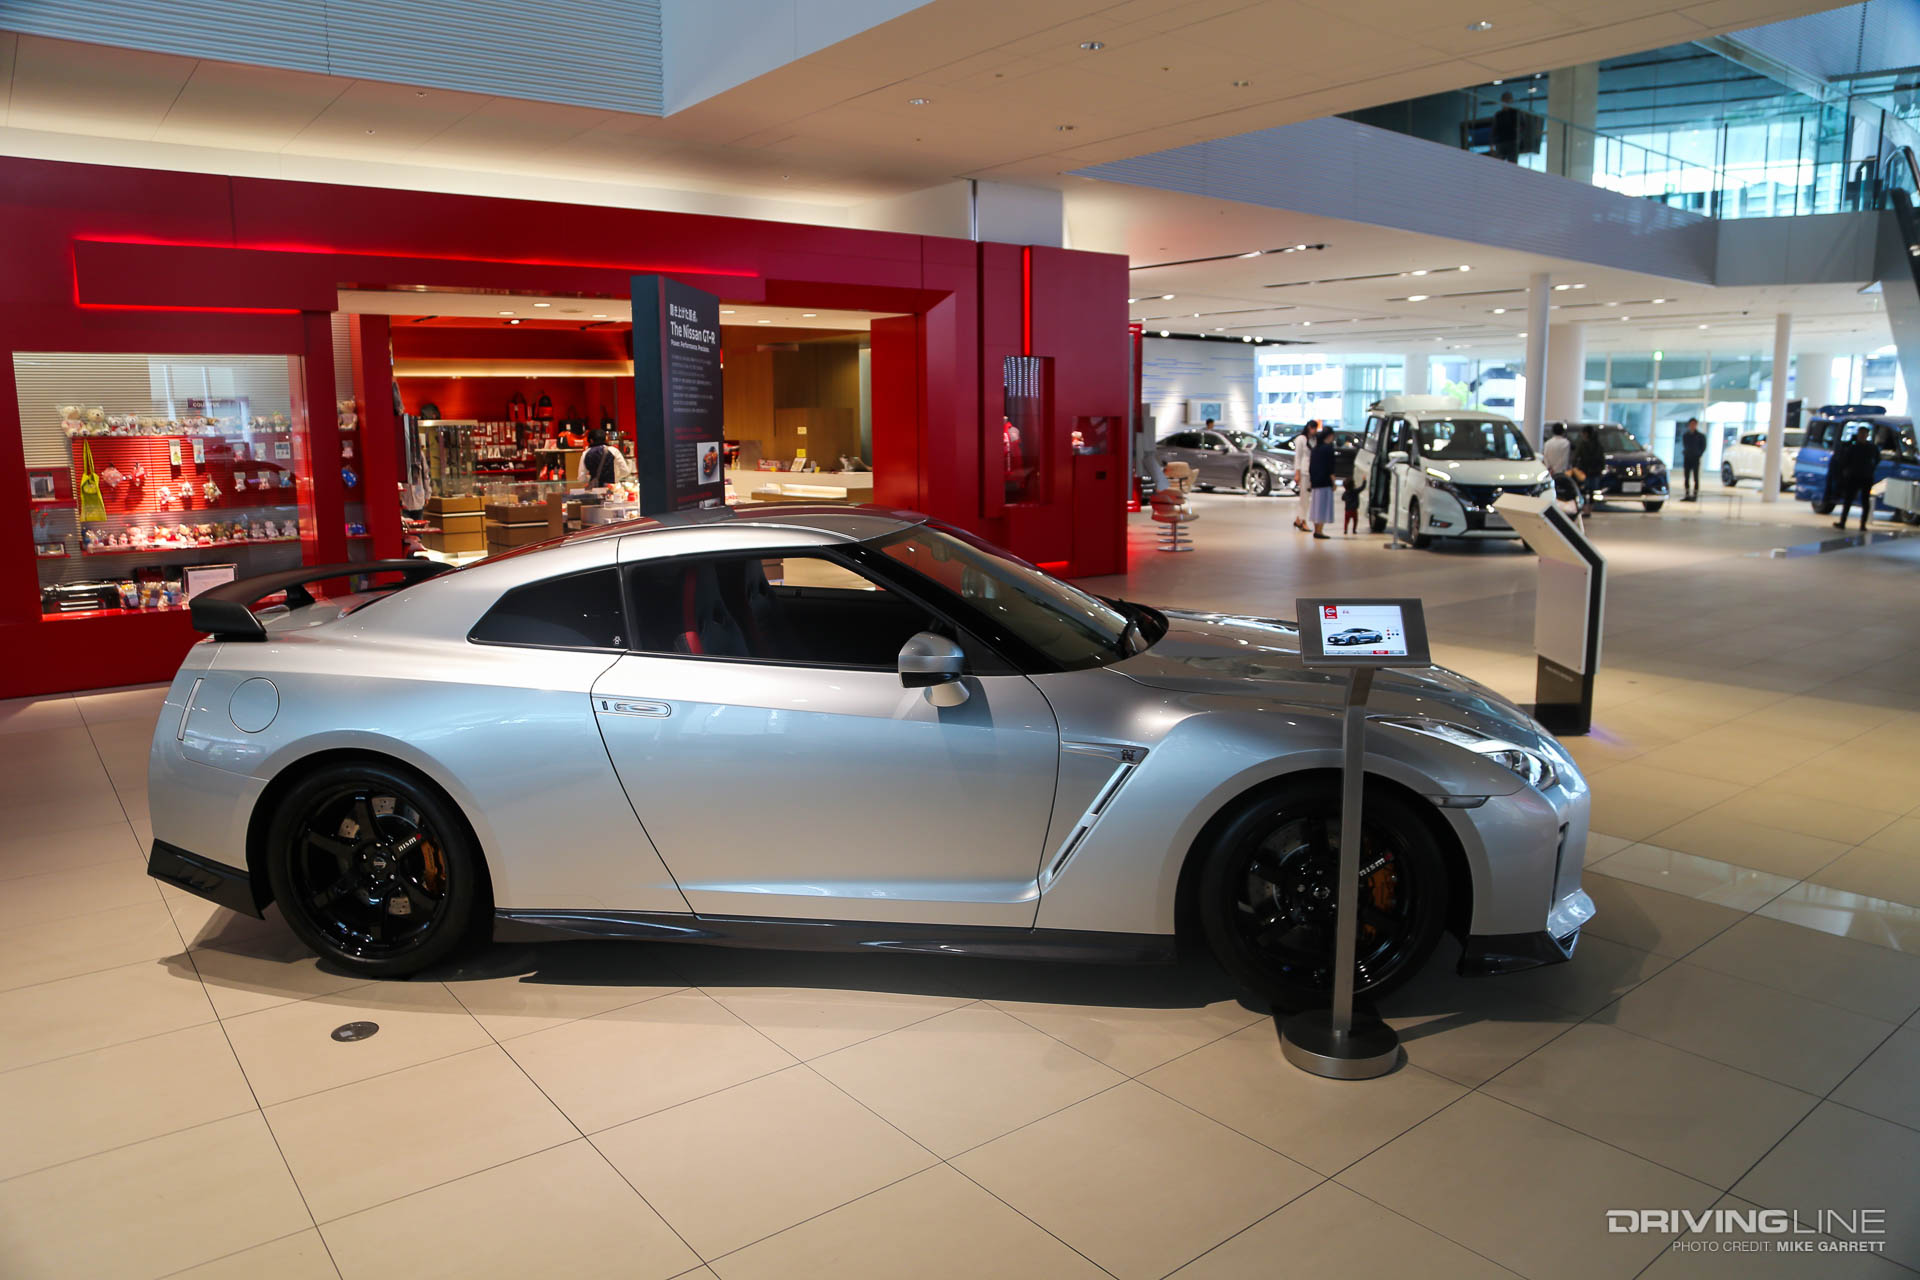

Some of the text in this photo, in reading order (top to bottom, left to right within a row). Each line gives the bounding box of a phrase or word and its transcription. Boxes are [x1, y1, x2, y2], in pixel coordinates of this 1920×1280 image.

[671, 321, 715, 344] The Nissan GT-R
